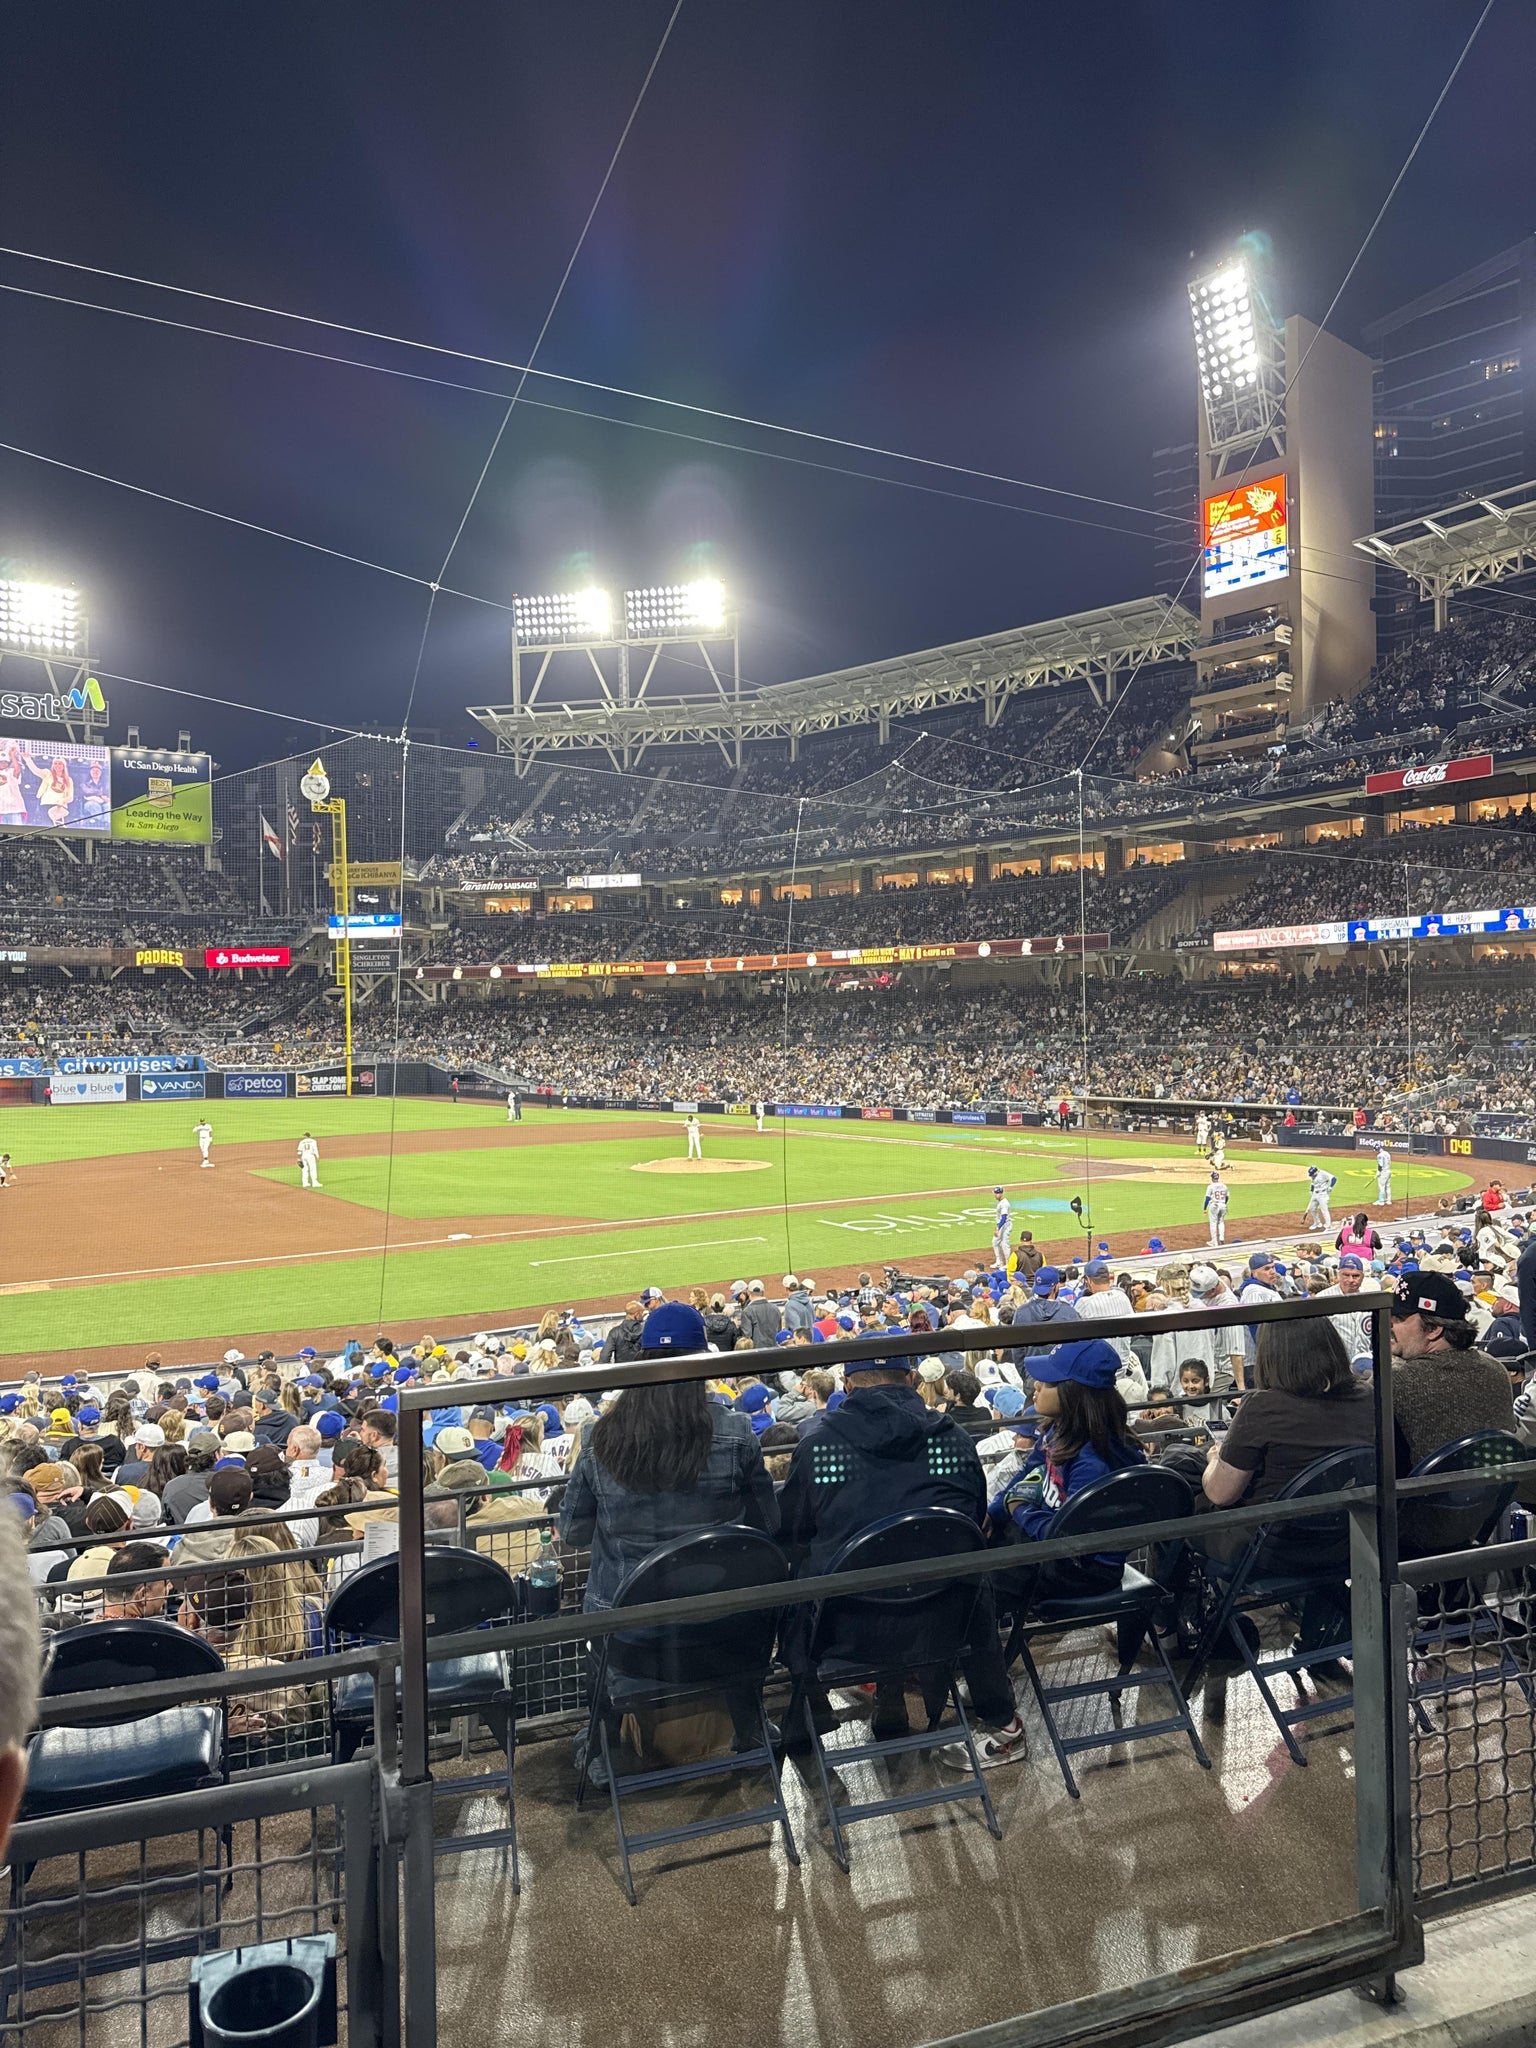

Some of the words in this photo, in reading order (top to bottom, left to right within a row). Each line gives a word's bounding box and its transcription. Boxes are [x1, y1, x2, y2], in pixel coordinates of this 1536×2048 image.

[123, 759, 137, 769] UC
[137, 761, 152, 771] San
[152, 763, 173, 774] Diego
[173, 763, 198, 775] Health
[1402, 764, 1448, 787] Coca-Cola
[150, 779, 171, 787] BEST
[126, 808, 164, 821] Leading
[165, 811, 181, 820] the
[182, 811, 203, 823] Way
[126, 820, 135, 829] in
[138, 821, 153, 830] San
[155, 822, 180, 832] Diego
[460, 880, 503, 891] Tarantino
[503, 881, 538, 890] SAUSAGES
[1333, 924, 1346, 933] DUE
[1337, 932, 1346, 941] UP
[1177, 940, 1200, 948] SONY
[136, 950, 183, 966] PADRES
[231, 953, 280, 964] Budweiser
[899, 948, 916, 960] MAY
[588, 963, 604, 975] MAY
[156, 1080, 203, 1090] VANDA
[244, 1076, 283, 1089] petco
[312, 1076, 329, 1085] SLAP
[52, 1083, 77, 1094] blue
[90, 1082, 114, 1092] blue
